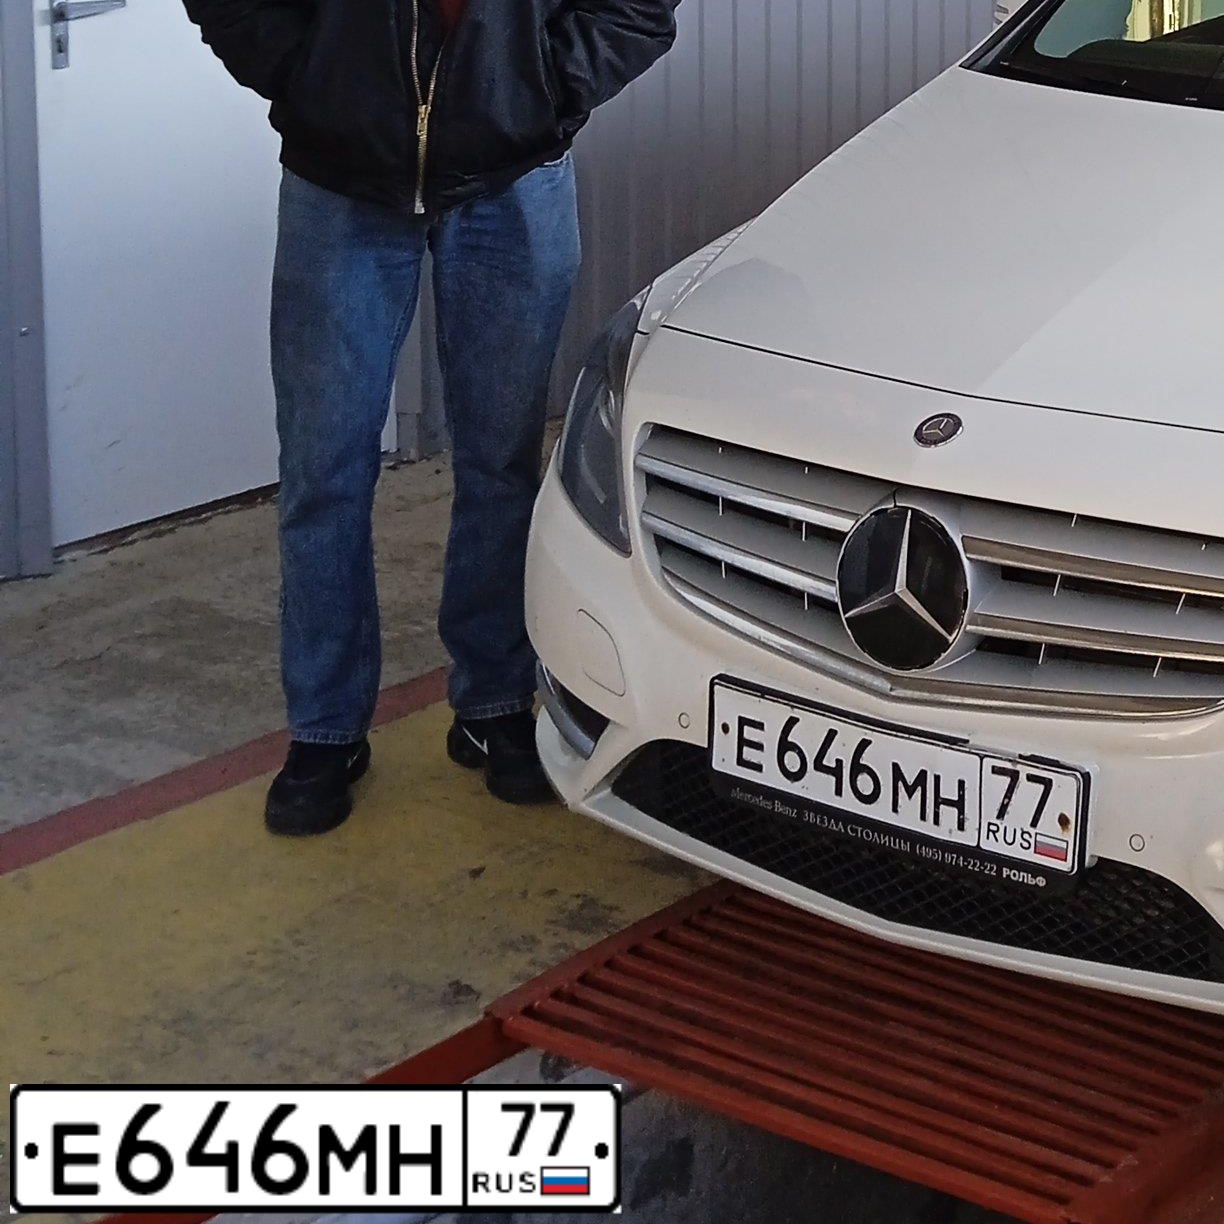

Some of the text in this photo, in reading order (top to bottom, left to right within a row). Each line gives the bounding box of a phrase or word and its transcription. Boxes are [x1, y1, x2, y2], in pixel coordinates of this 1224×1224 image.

[991, 765, 1054, 829] 77
[802, 809, 845, 833] ЗВЕЗДА
[847, 823, 911, 853] СТОЛИЦЫ
[915, 842, 942, 862] (495)
[1002, 866, 1047, 887] РОЛЬФ
[986, 822, 1033, 851] RUS
